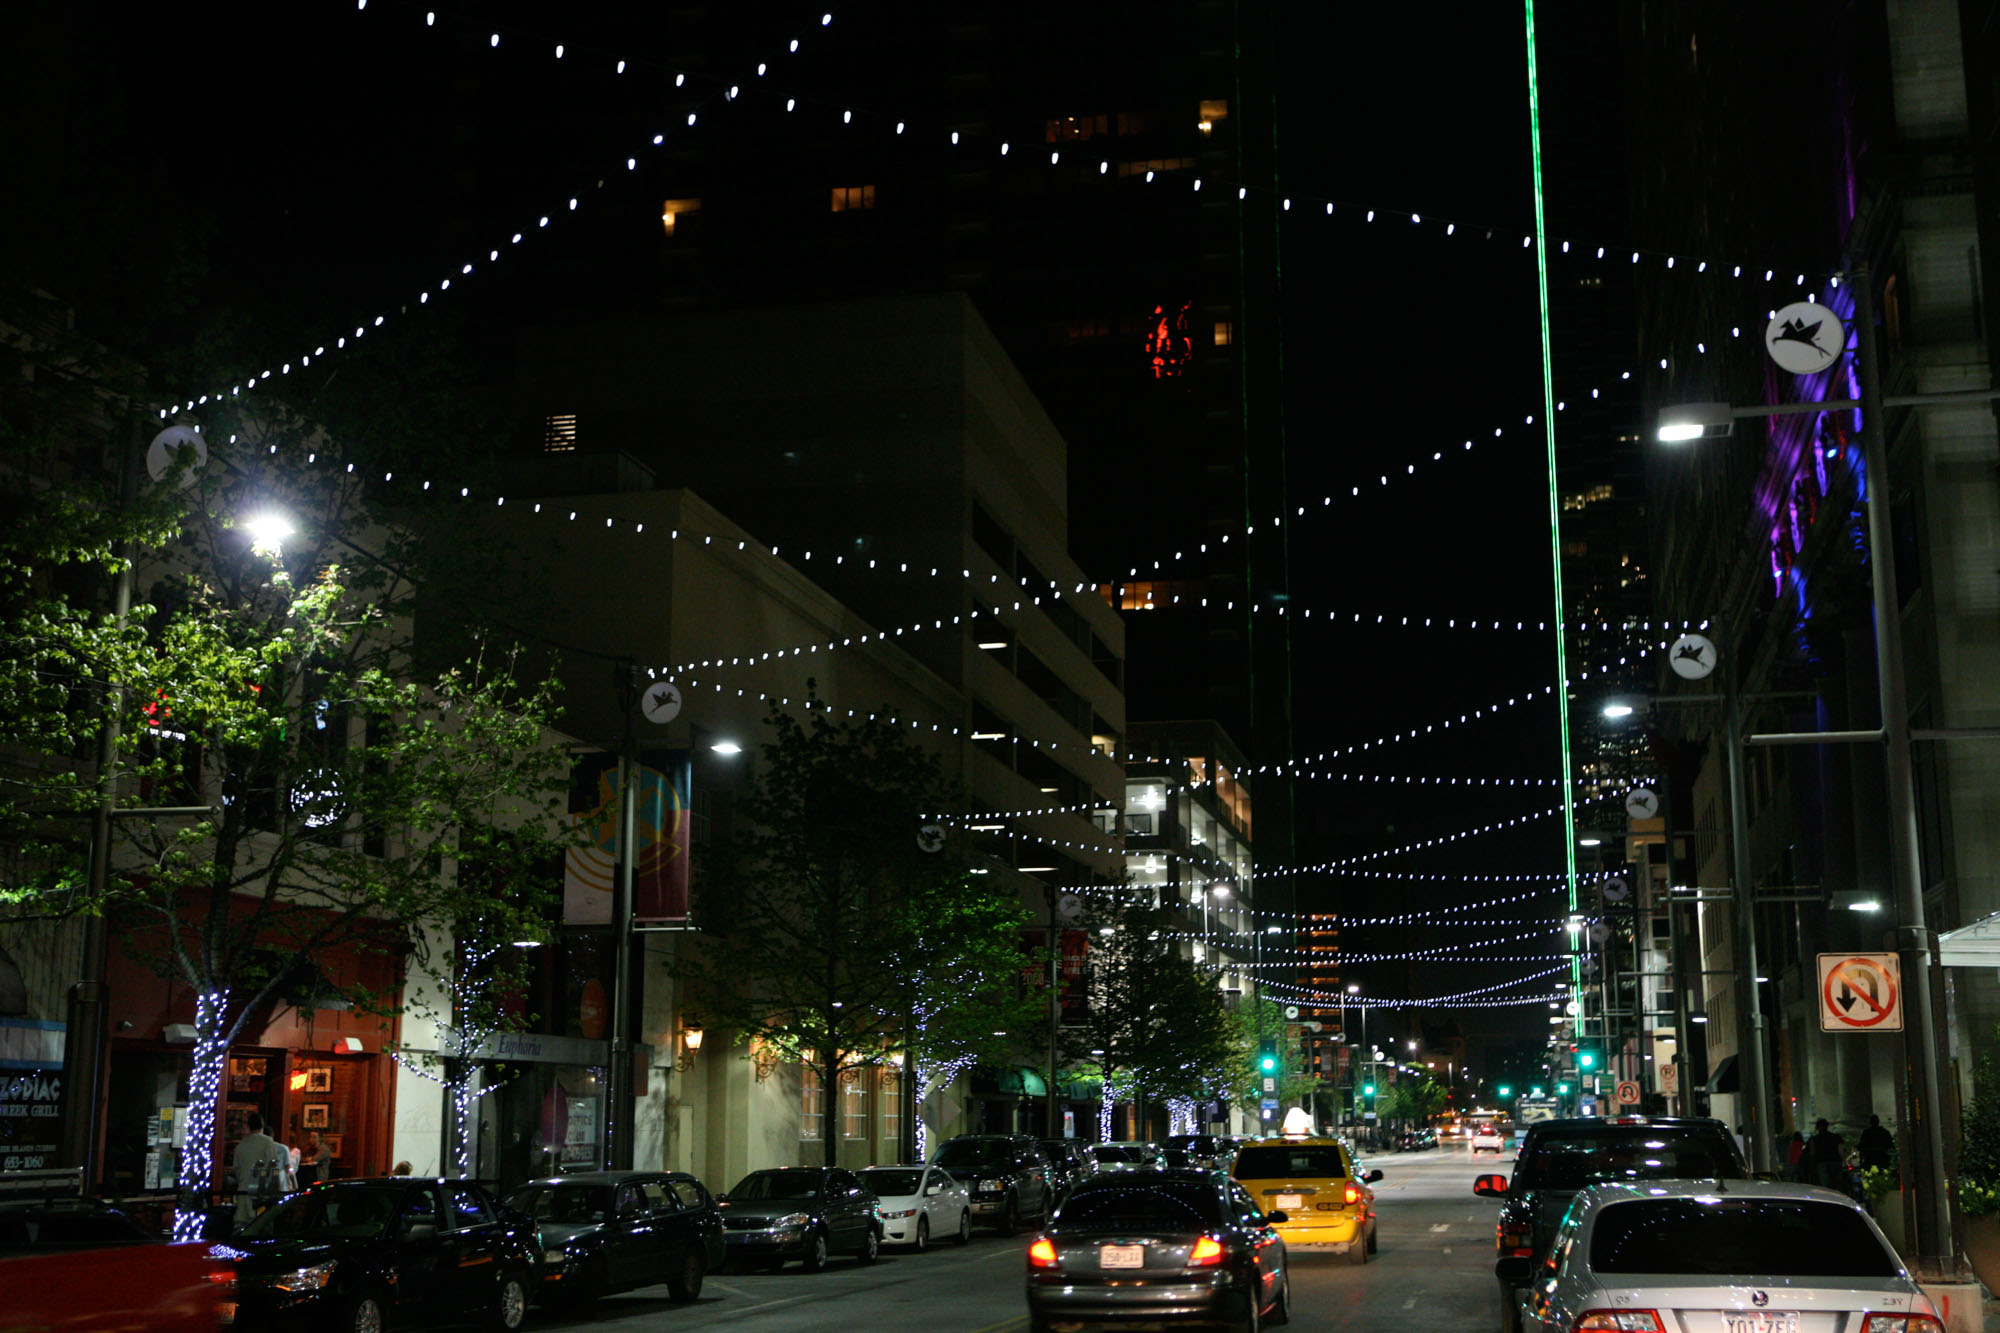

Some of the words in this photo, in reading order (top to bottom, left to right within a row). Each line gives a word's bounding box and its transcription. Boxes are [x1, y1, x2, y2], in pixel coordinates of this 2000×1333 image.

[0, 1076, 61, 1101] ZODIAC
[0, 1104, 29, 1117] REEK
[31, 1104, 60, 1117] GRILL
